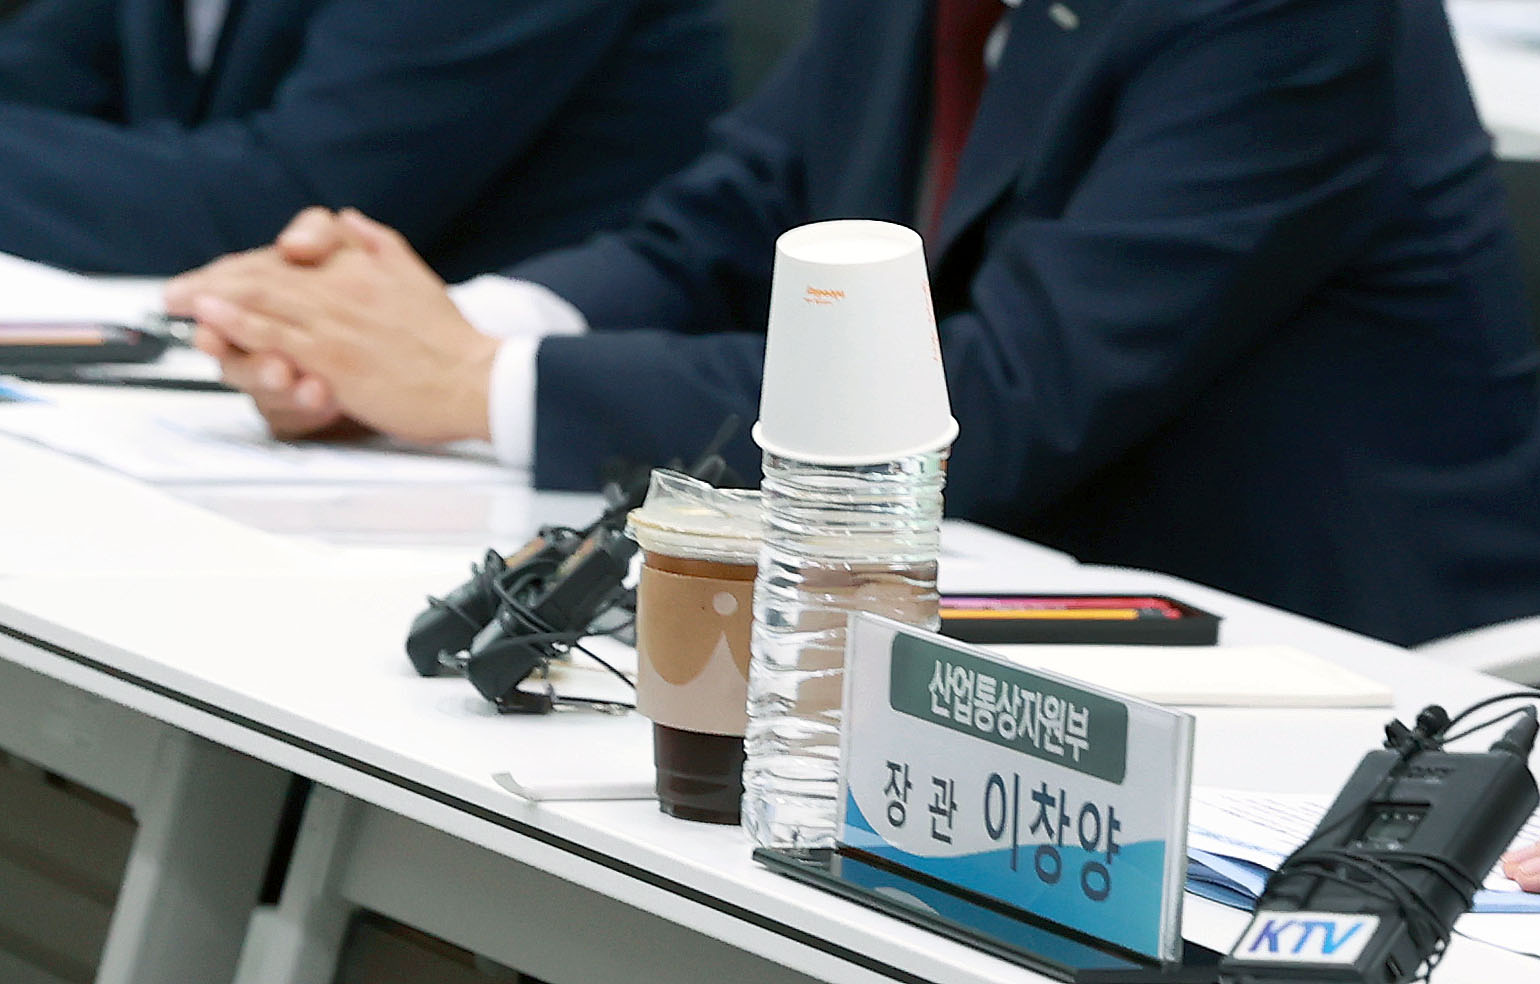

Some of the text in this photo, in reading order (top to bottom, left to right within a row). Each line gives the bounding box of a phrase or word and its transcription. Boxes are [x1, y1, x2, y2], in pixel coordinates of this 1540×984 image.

[928, 659, 1091, 763] 산업통상자원부
[984, 771, 1122, 903] 이창양
[1249, 919, 1364, 955] KTV
